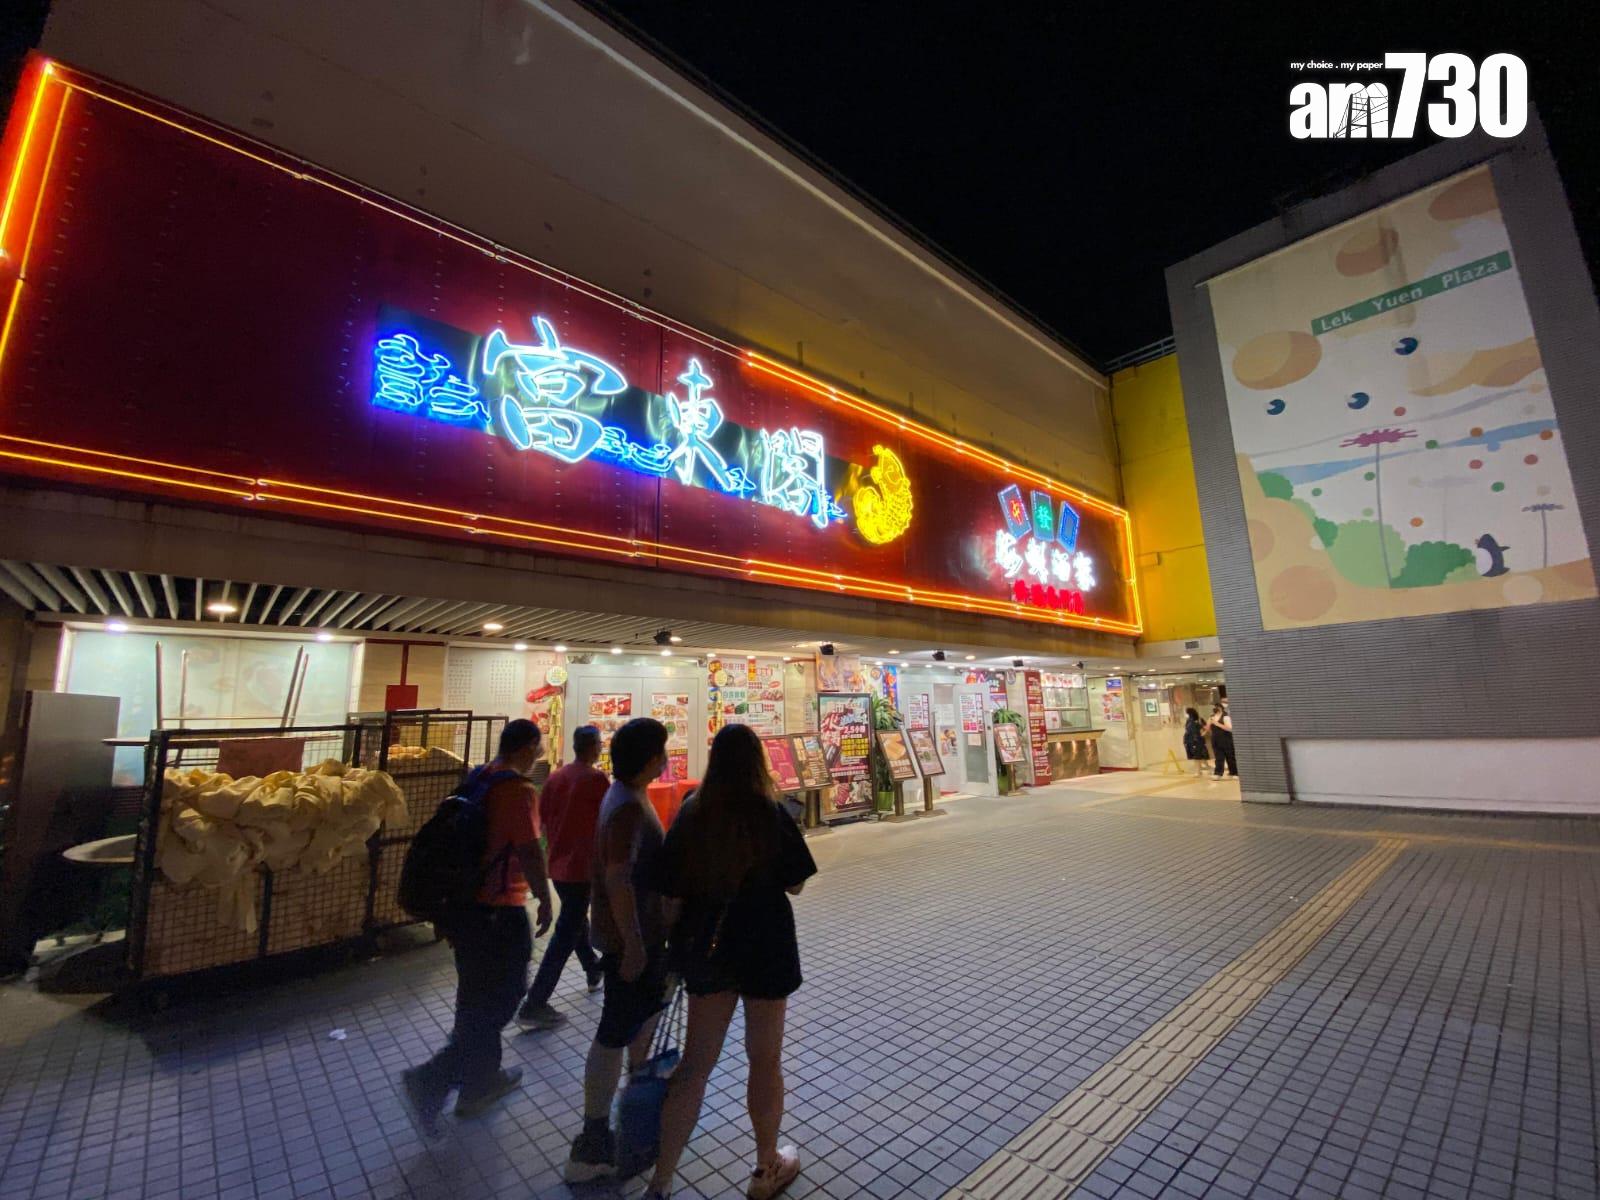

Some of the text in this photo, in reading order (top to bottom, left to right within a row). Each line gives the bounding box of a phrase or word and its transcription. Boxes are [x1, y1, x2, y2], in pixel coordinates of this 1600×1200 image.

[1321, 260, 1499, 332] Lek Yuen Plaza
[482, 315, 830, 529] 富東閣
